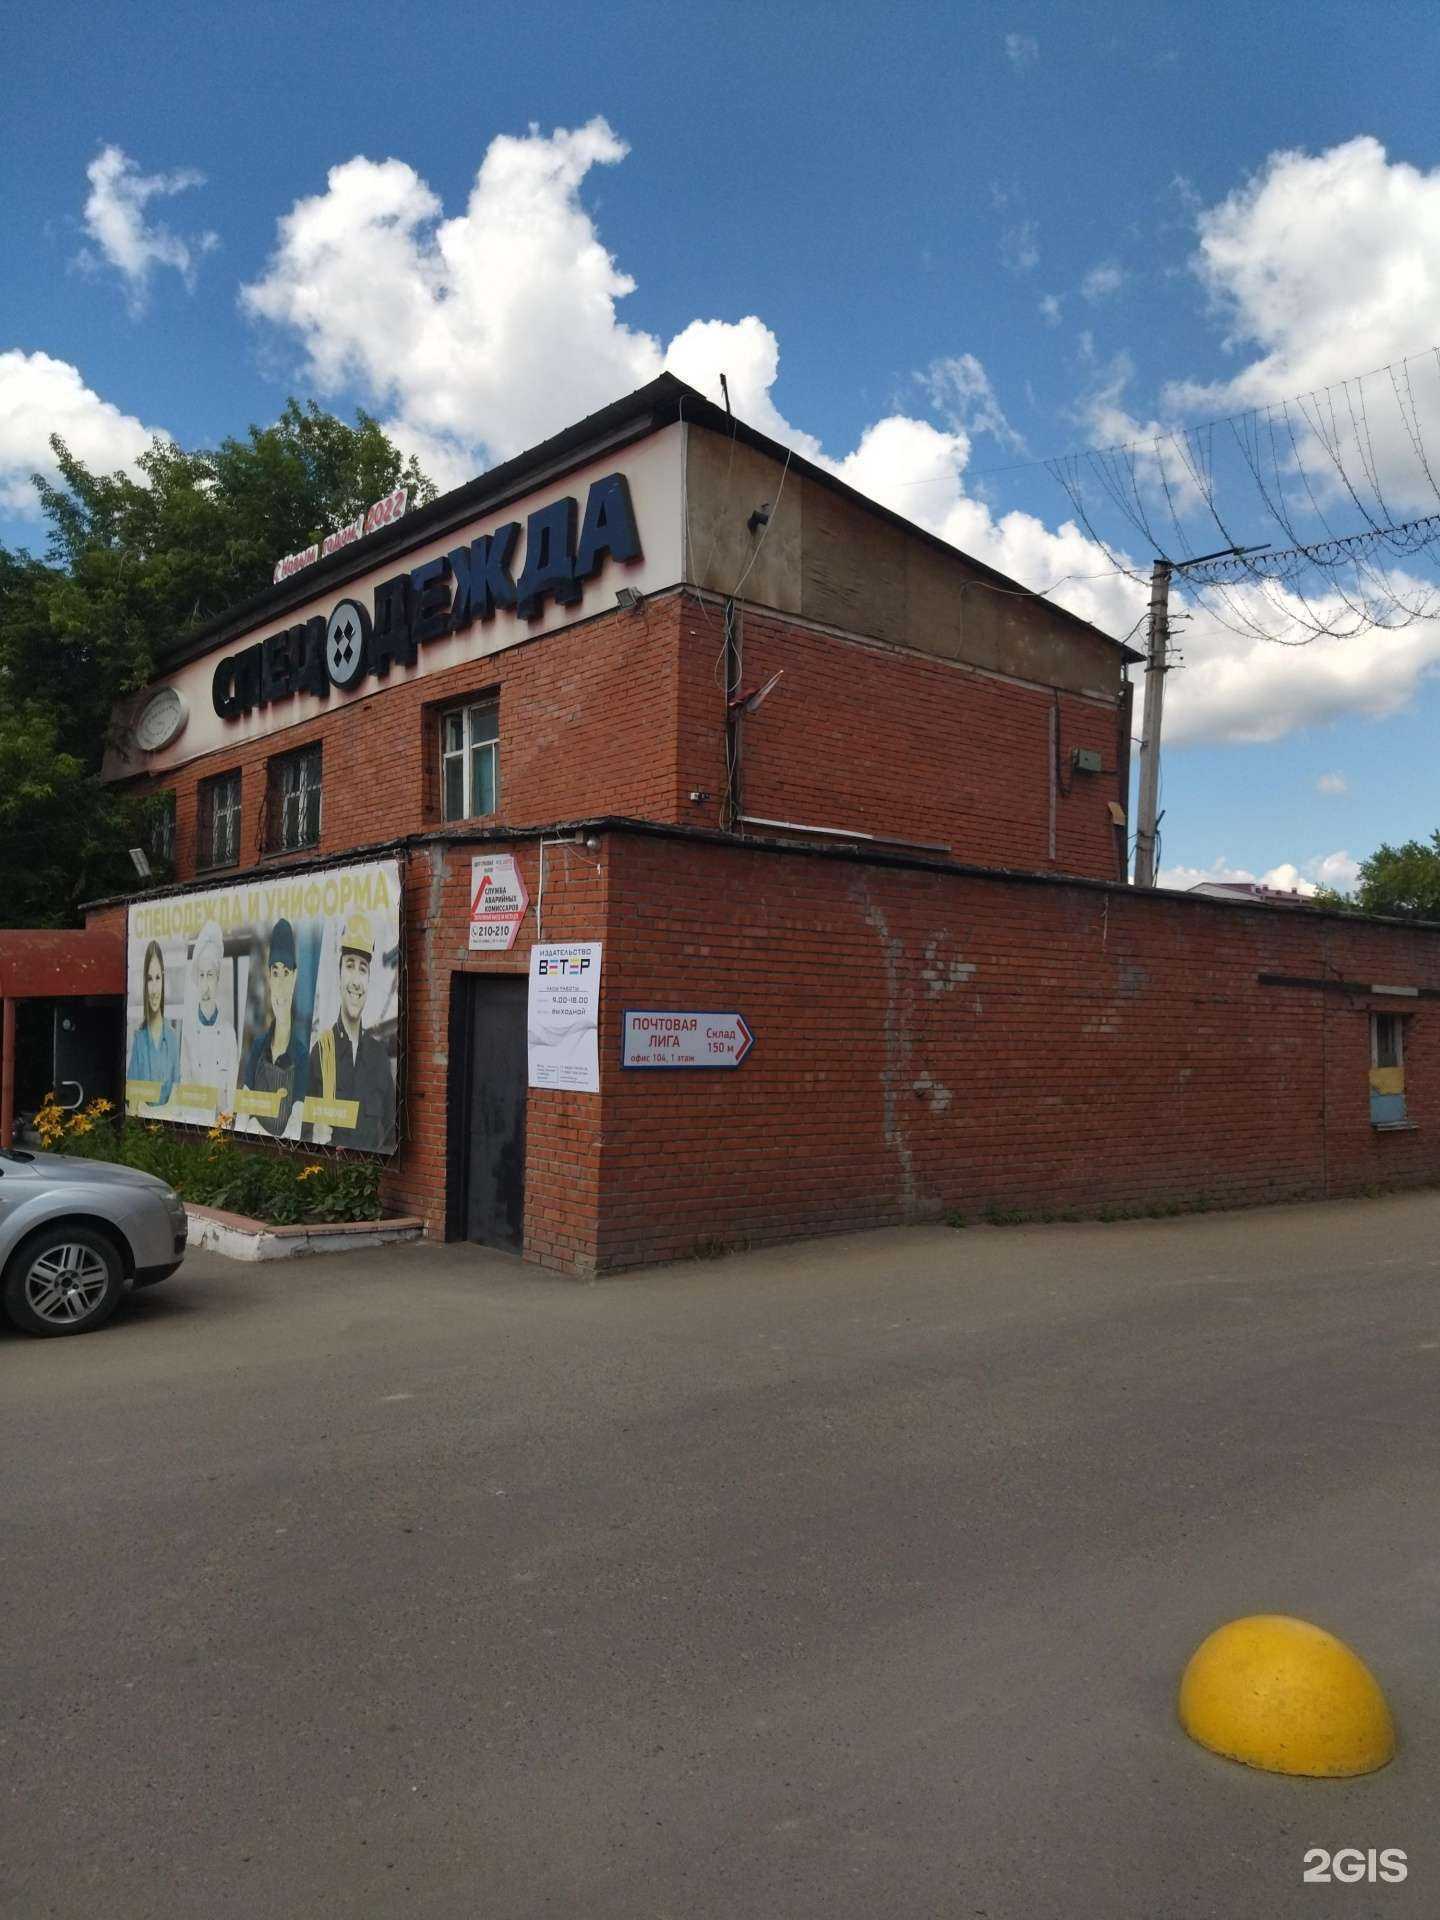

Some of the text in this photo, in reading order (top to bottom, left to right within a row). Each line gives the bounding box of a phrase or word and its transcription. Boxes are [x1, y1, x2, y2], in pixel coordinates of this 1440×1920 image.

[212, 472, 645, 719] СПЕЦОДЕЖДА
[485, 886, 507, 896] СЛУЖБА
[136, 870, 390, 940] СПЕЦОДЕЖДА И УНИФОРМА
[485, 894, 517, 904] АВАРИЙНЫХ
[485, 903, 519, 913] КОМИССАРОВ
[478, 925, 510, 937] 210-210
[539, 948, 592, 957] ИЗДАТЕЛЬСТВО
[538, 958, 591, 976] ВЕТЕР
[632, 1017, 697, 1031] ПОЧТОВАЯ
[706, 1027, 736, 1040] Склад
[648, 1035, 681, 1048] ЛИГА
[708, 1042, 725, 1053] 150
[630, 1053, 651, 1063] офис
